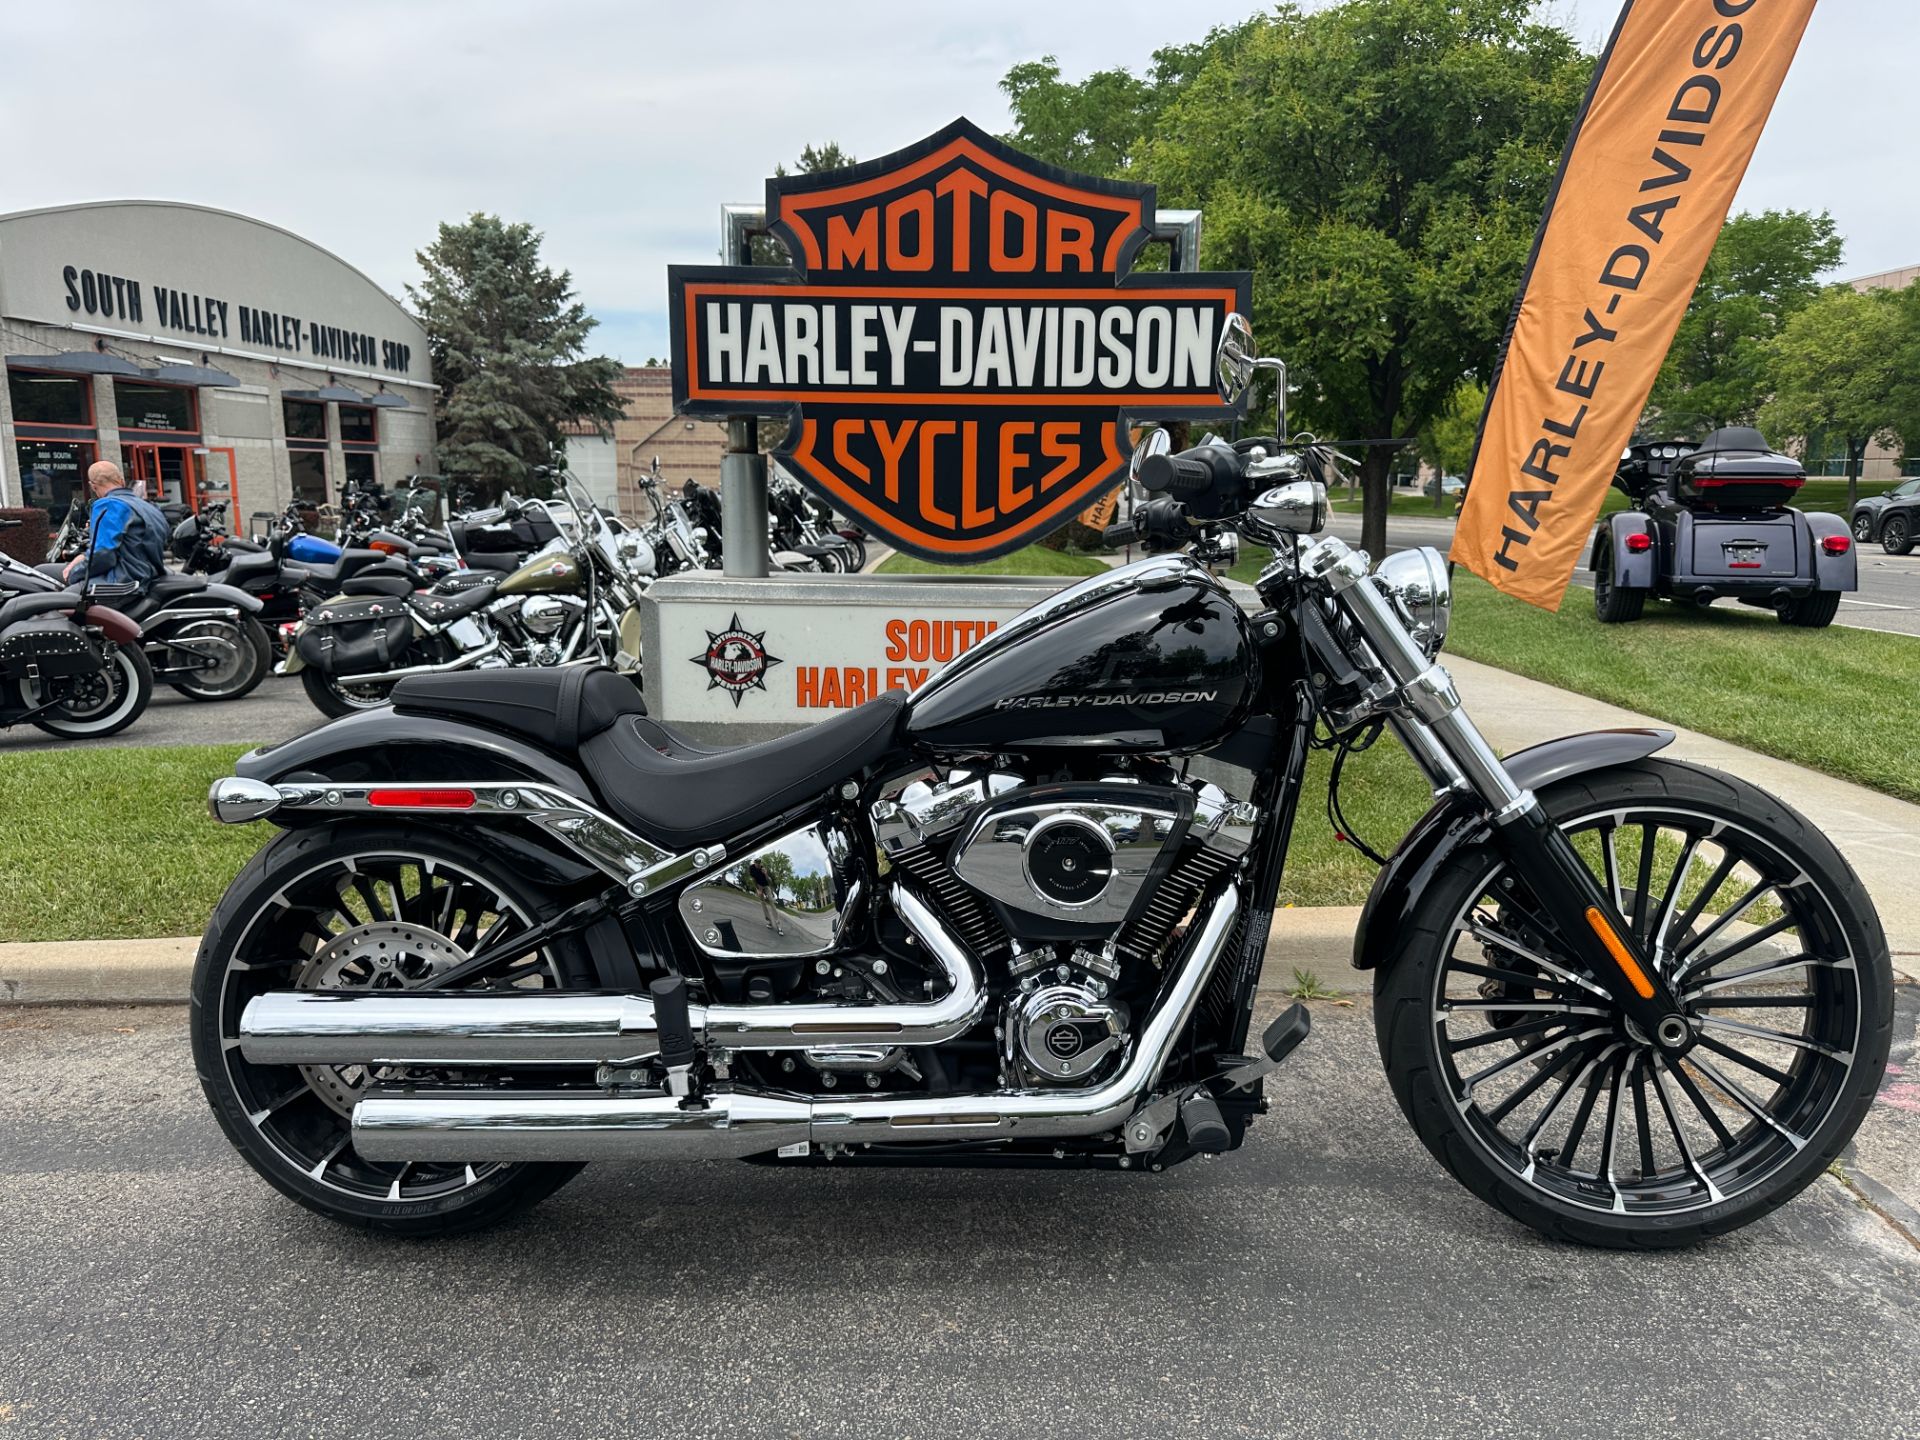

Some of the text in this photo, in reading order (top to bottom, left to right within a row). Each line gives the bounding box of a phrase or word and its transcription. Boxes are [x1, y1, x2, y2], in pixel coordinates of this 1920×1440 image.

[827, 166, 1095, 273] MOTOR
[63, 265, 411, 373] SOUTH VALLEY HARLEY-DAVIDSON SHOP
[706, 301, 1214, 388] HARLEY-DAVIDSON
[832, 419, 1081, 530] CYCLES
[710, 656, 763, 673] HARLEY-DAVIDSON
[711, 631, 761, 650] AUTHORIZED
[713, 674, 760, 690] RENTALS
[994, 690, 1218, 710] HARLEY-DAVIDSON
